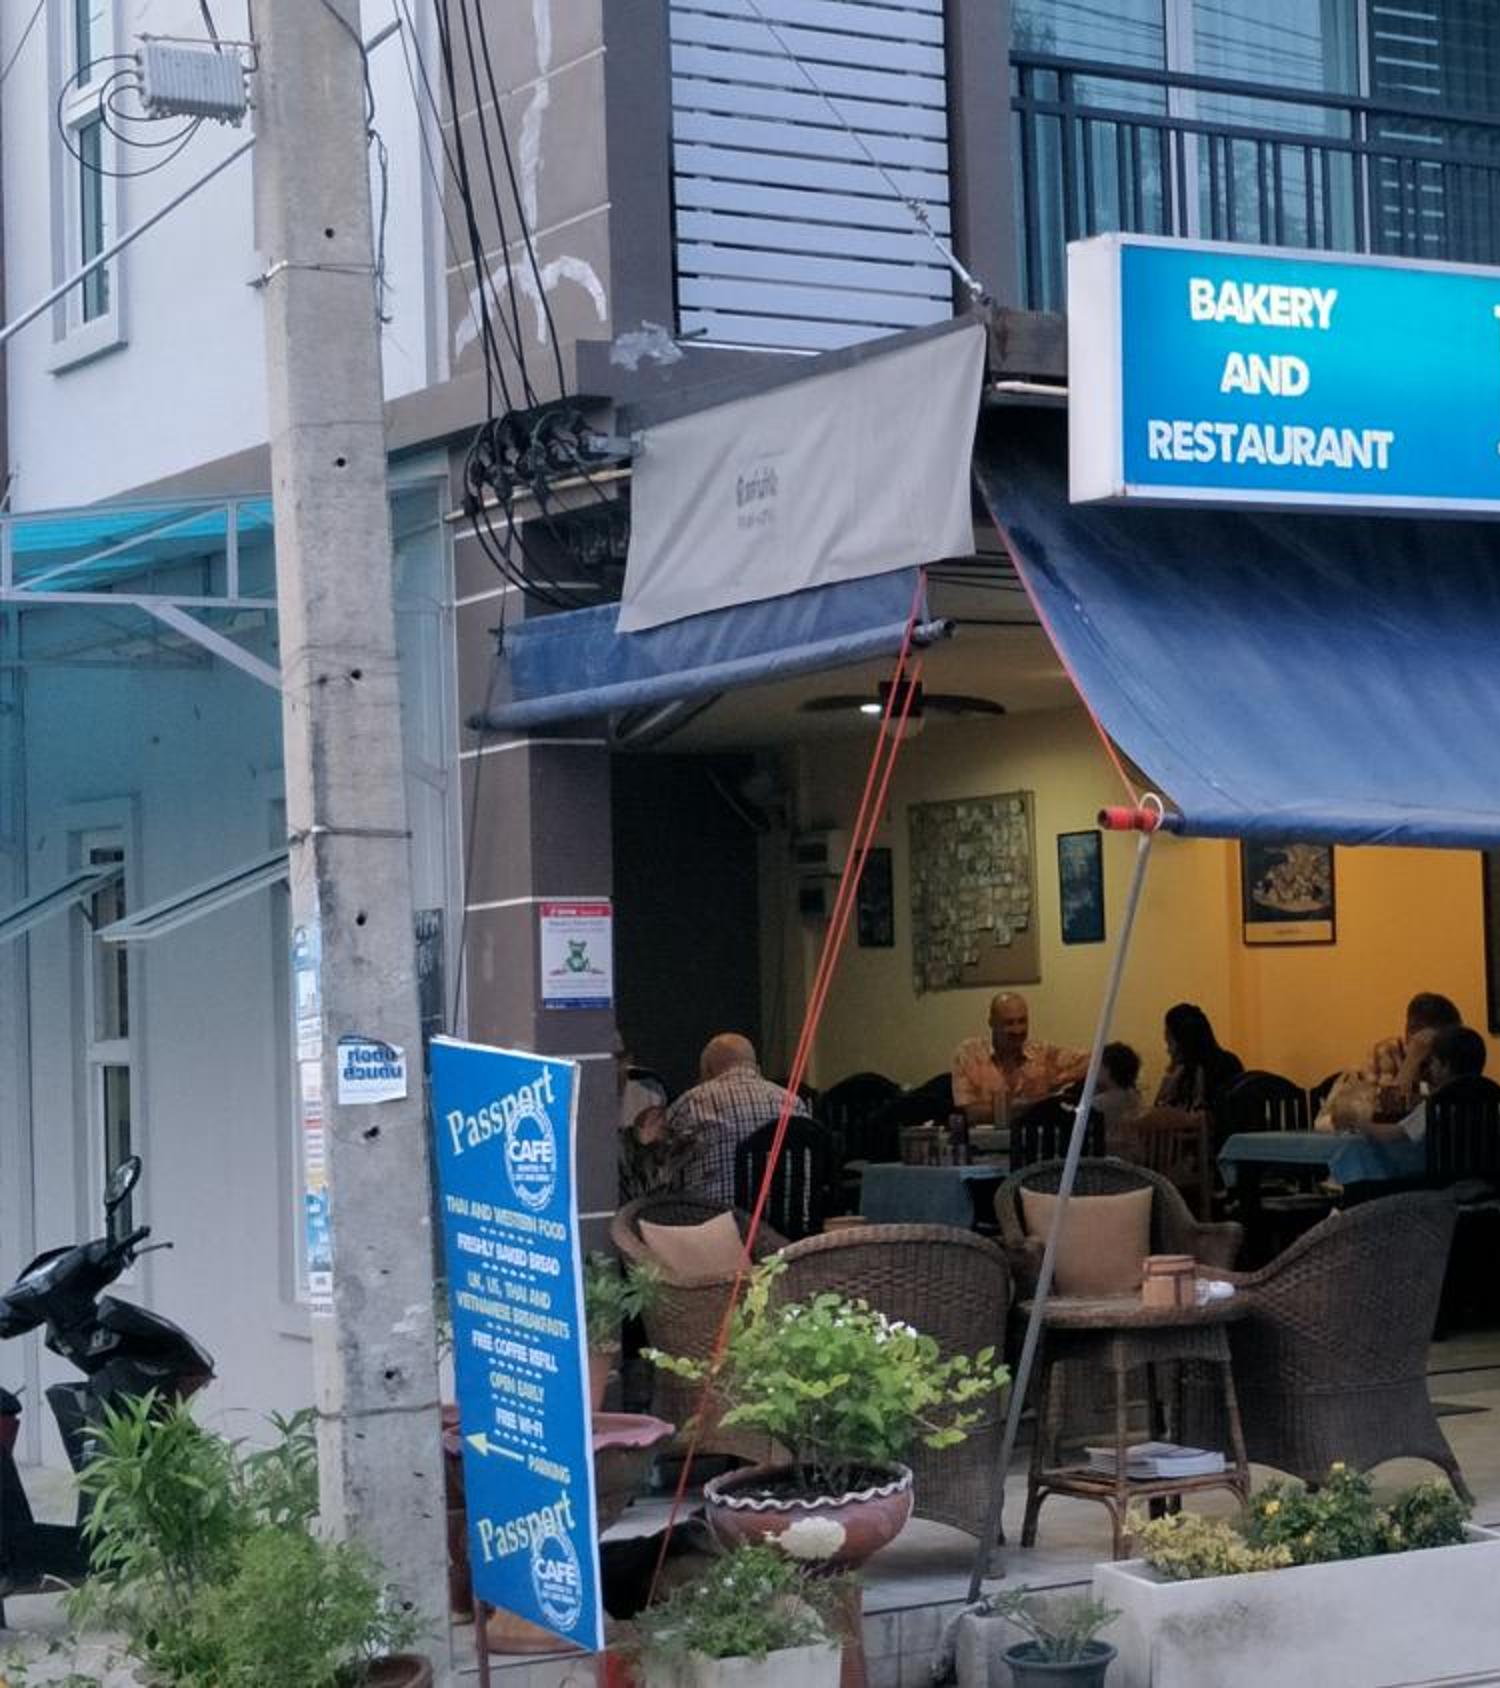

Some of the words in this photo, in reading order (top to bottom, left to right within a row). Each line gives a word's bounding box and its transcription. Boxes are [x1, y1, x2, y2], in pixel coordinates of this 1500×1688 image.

[1189, 278, 1338, 330] BAKERY
[1220, 352, 1310, 397] AND
[1148, 420, 1395, 470] RESTAURANT
[446, 1064, 555, 1156] Passport
[509, 1139, 553, 1163] CAFE
[446, 1194, 469, 1216] THAI
[537, 1217, 567, 1241] FOOD
[489, 1371, 516, 1395] OPEN
[495, 1406, 518, 1430] FREE
[477, 1488, 576, 1563] Passport
[535, 1557, 577, 1587] CAFE
